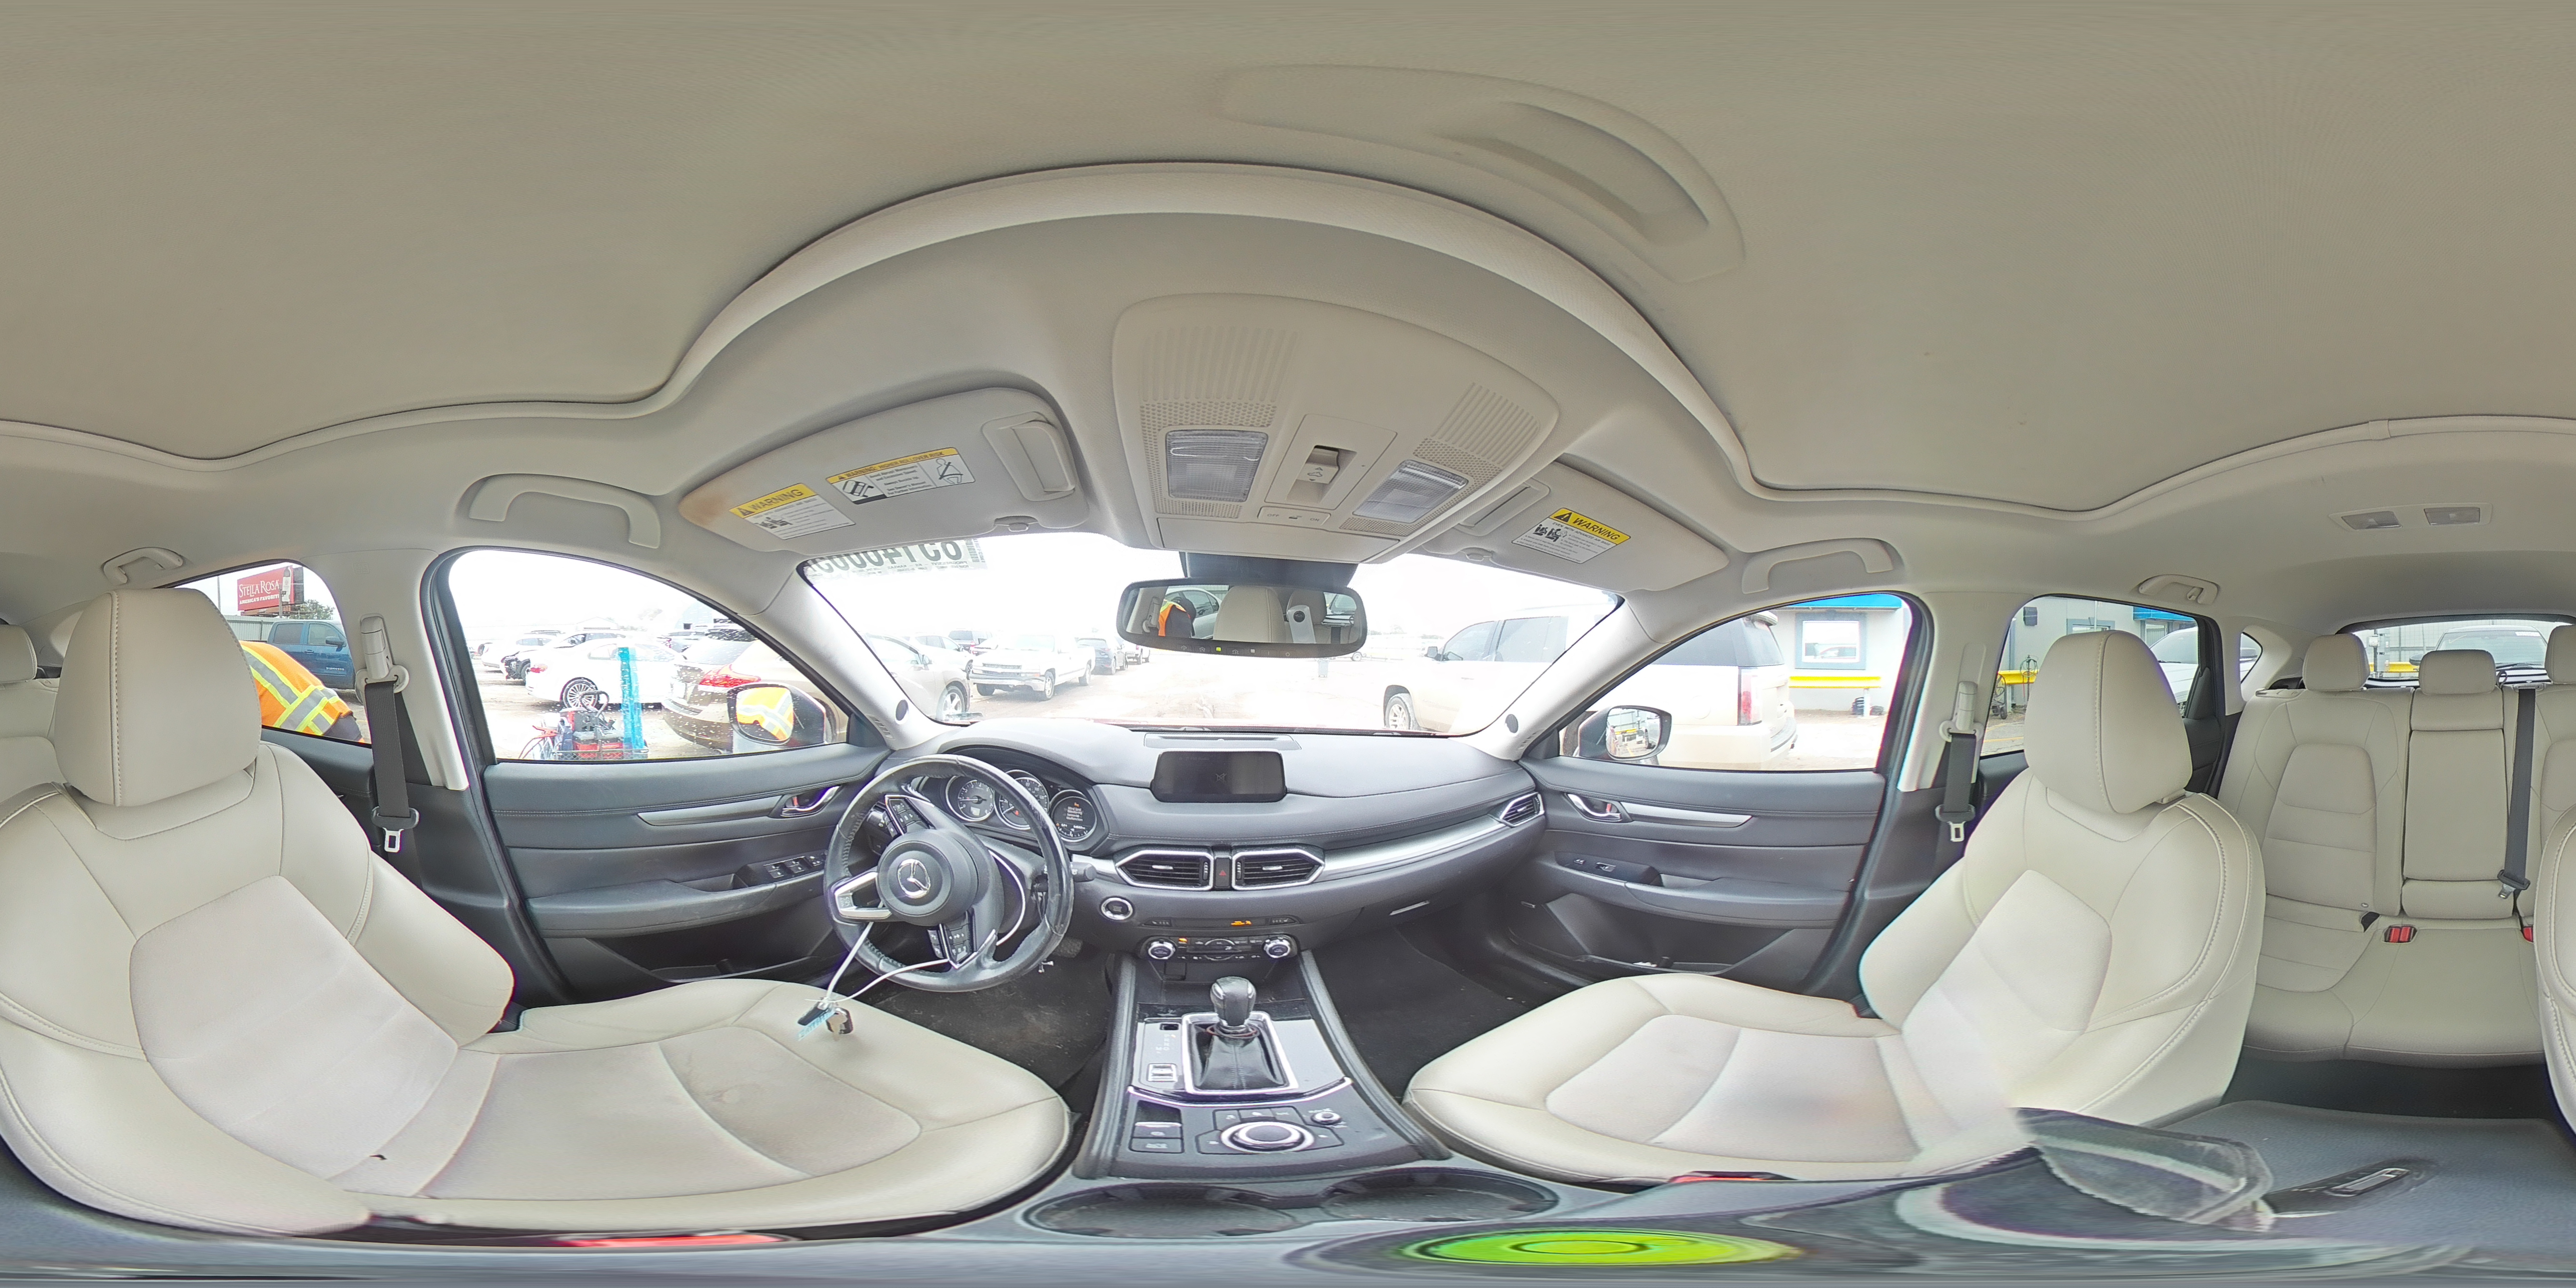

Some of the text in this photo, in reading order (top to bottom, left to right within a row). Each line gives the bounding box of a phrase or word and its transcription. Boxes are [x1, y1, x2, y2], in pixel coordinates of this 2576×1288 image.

[899, 455, 929, 464] ROLLOVER
[748, 489, 804, 511] WARNING
[1573, 518, 1620, 540] WARNING
[1575, 530, 1594, 539] ADVANCED
[239, 580, 279, 598] STELLA ROSA
